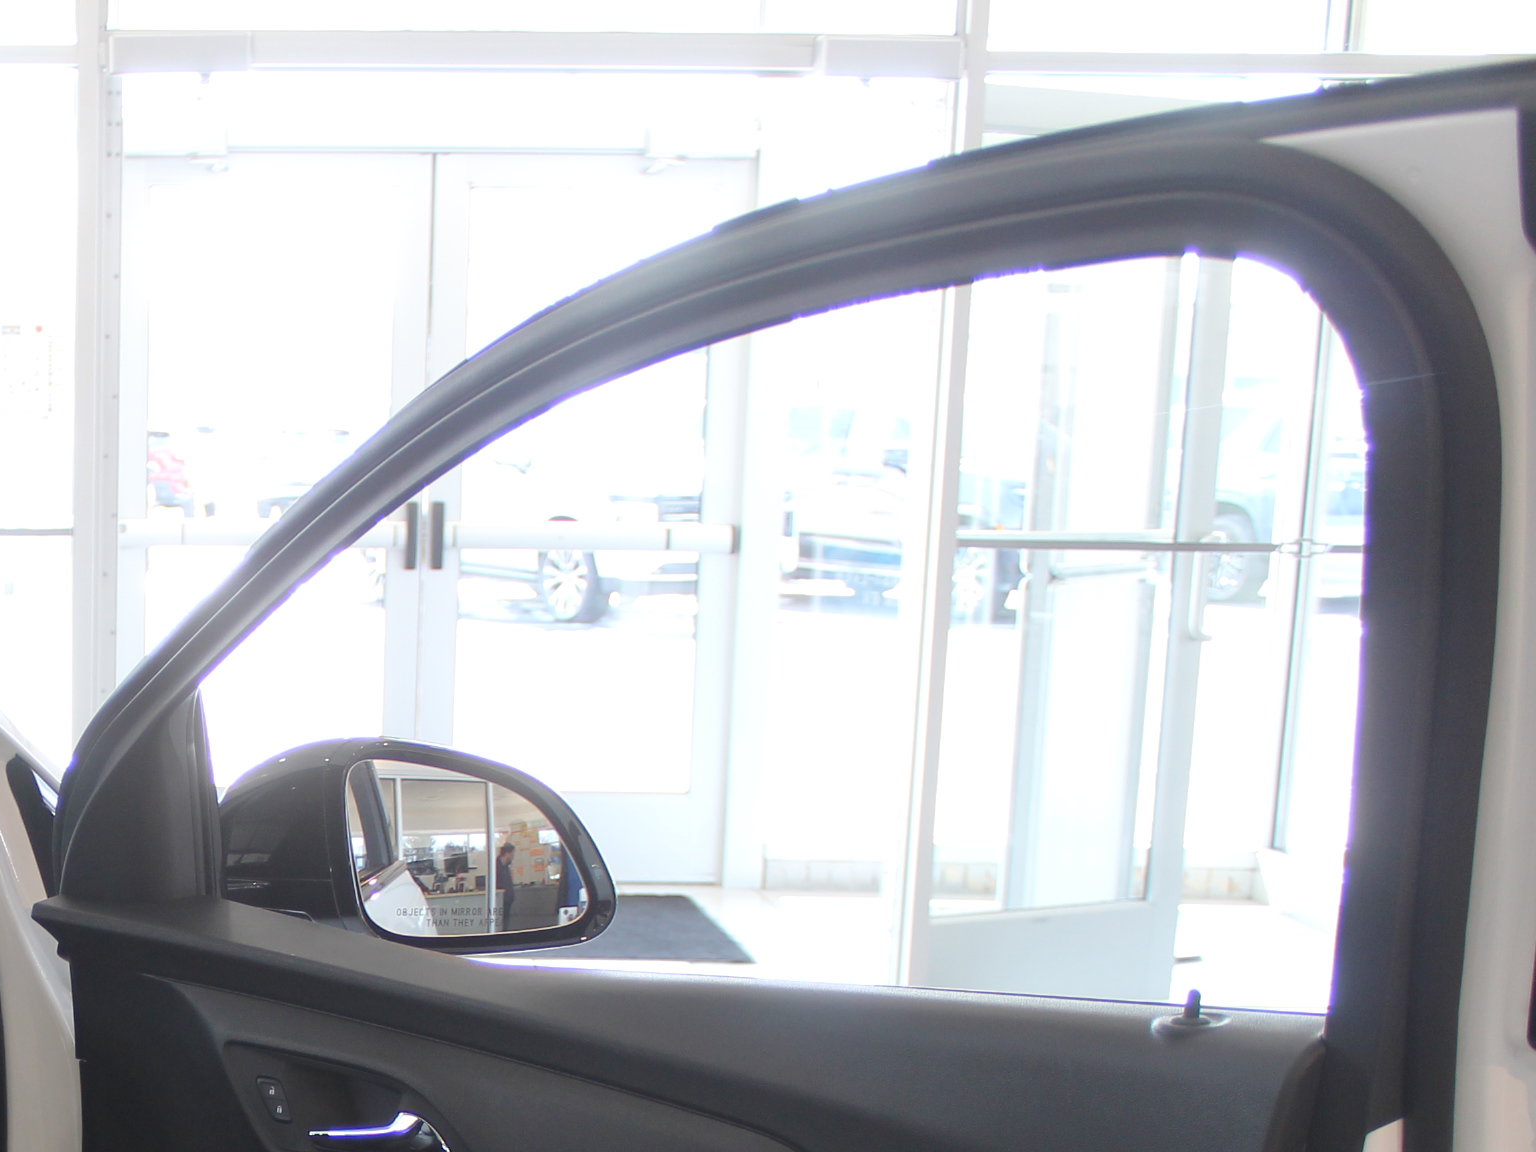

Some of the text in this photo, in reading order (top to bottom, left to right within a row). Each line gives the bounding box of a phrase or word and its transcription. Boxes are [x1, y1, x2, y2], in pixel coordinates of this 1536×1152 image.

[396, 907, 504, 917] OBJECTS IN MIRROR ARE
[426, 918, 450, 928] THAN
[453, 918, 475, 928] THEY
